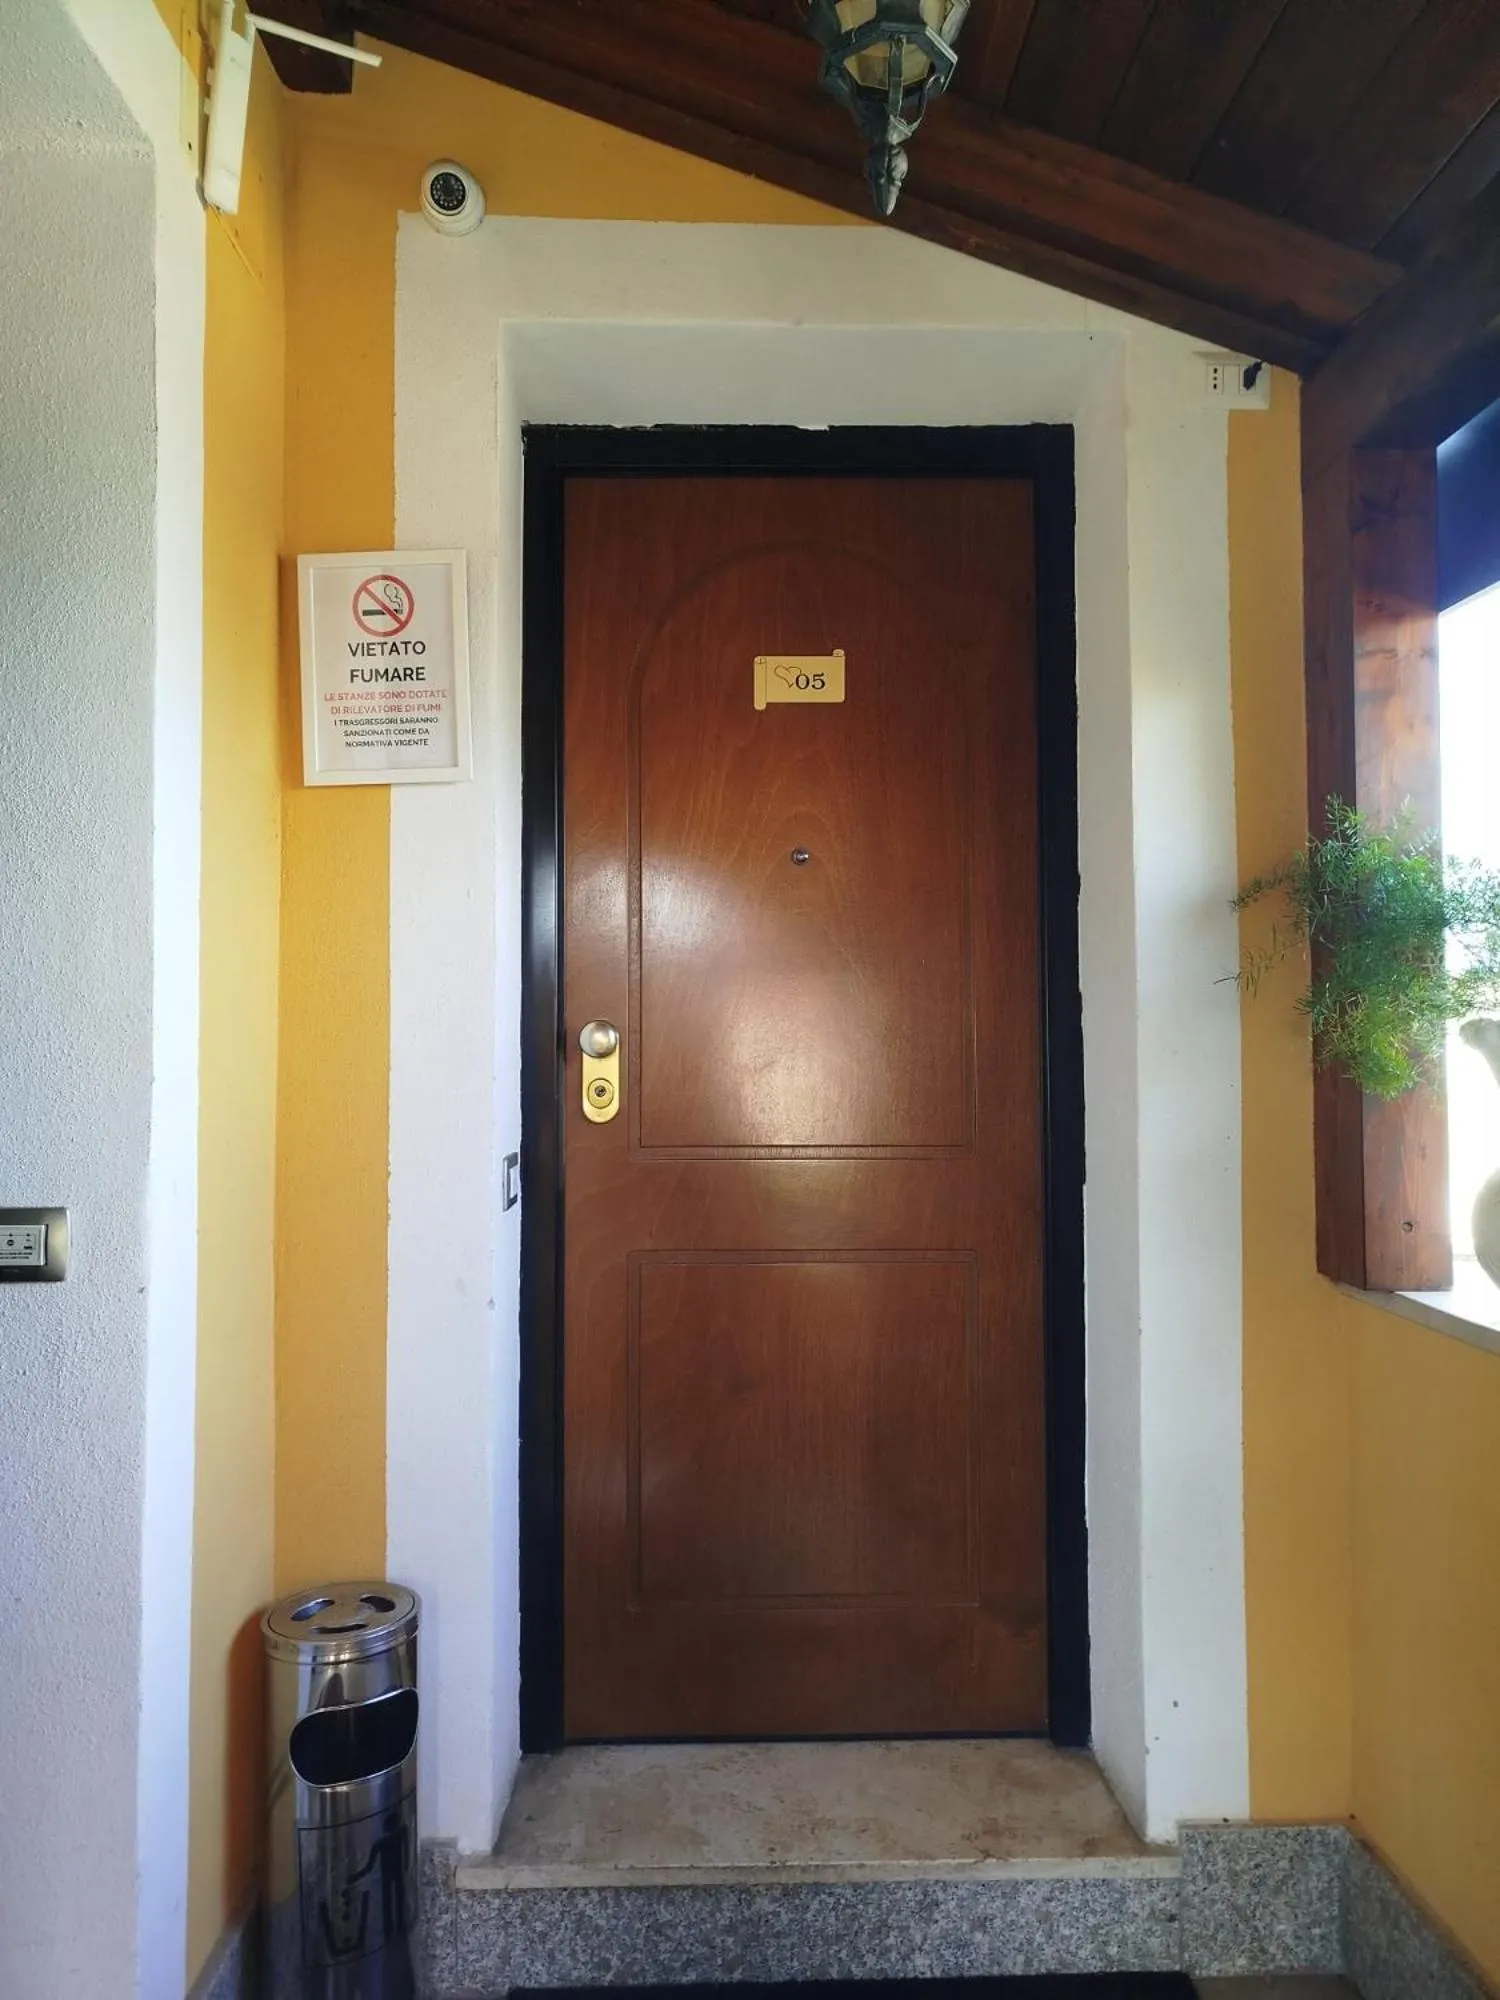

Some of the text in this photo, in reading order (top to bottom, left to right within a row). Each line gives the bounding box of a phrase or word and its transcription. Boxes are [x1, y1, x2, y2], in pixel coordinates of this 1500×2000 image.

[348, 641, 426, 657] VIETATO
[350, 667, 426, 683] FUMARE
[795, 673, 825, 690] 05
[324, 690, 447, 702] LE STANZE SONO DOTATE
[331, 706, 341, 715] DI
[405, 703, 414, 713] DI
[416, 703, 441, 712] FUMI
[339, 718, 398, 726] TRASGRESSORI
[400, 716, 439, 725] SARANNO
[343, 727, 430, 737] SANZIONATI COME DA
[345, 738, 429, 748] NORMATIVA VIGENTE
